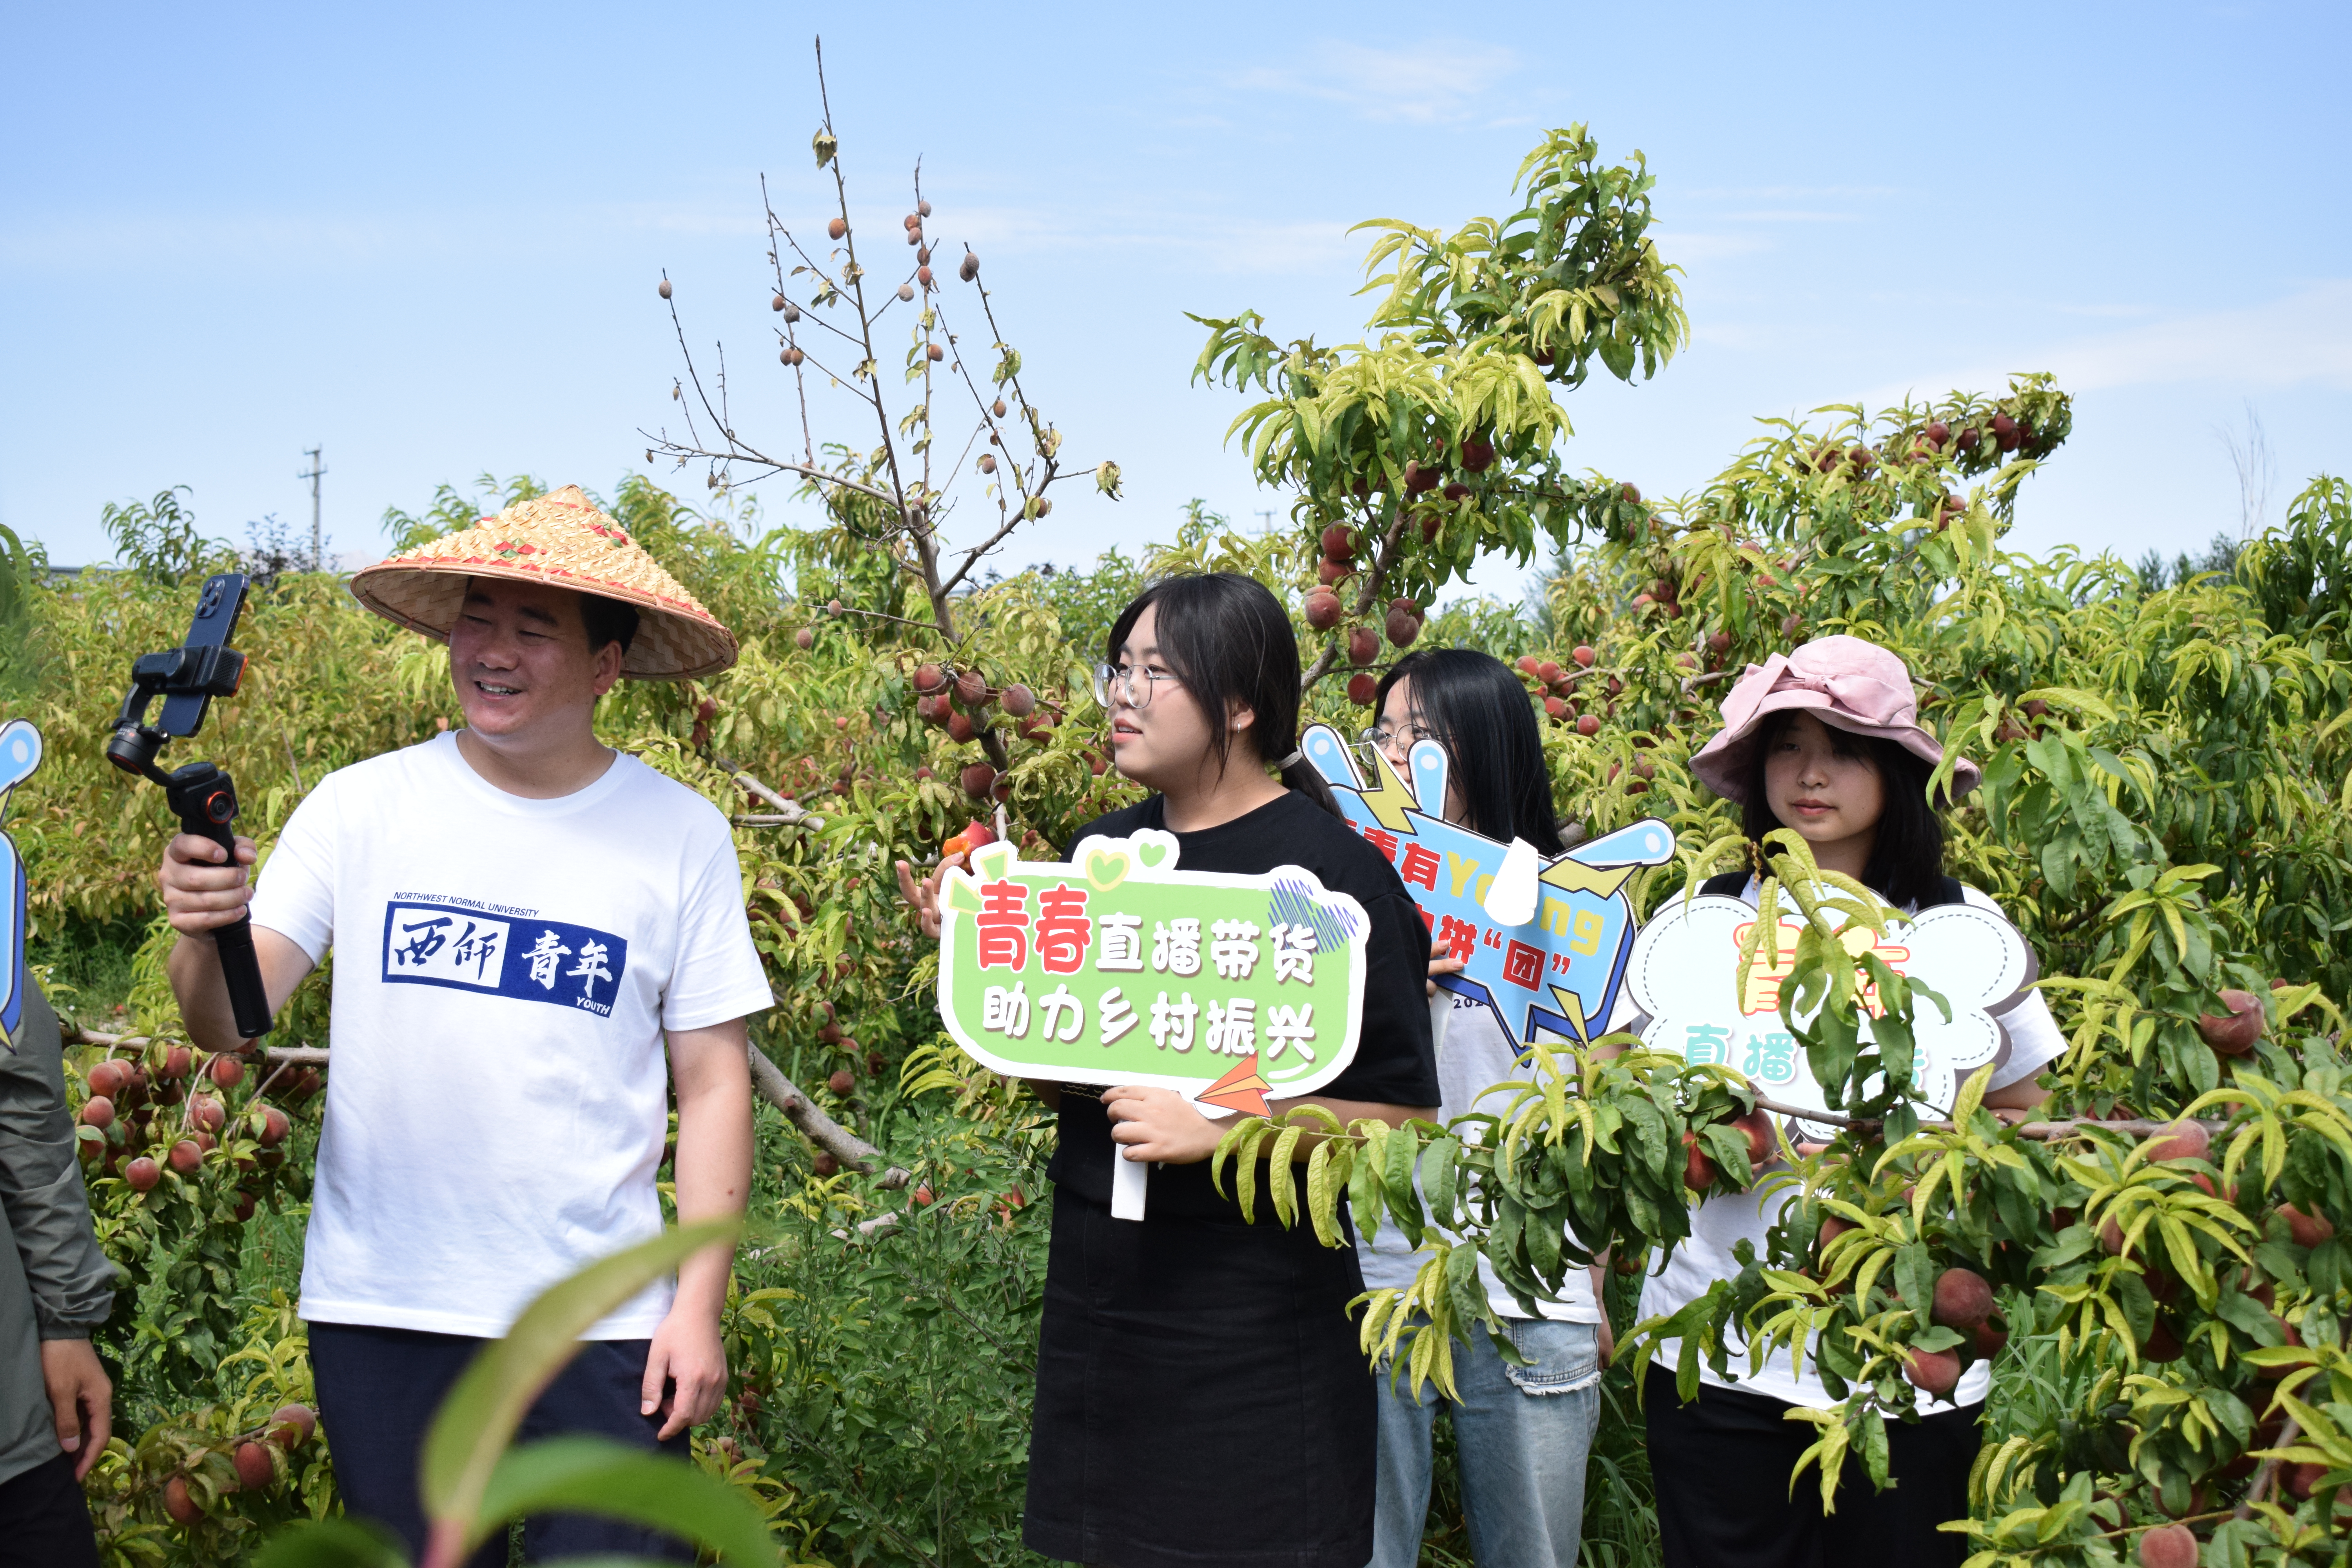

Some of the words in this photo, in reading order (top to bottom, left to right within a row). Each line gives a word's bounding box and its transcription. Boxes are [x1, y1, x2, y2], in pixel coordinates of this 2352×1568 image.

[394, 892, 448, 903] NORTHWEST
[448, 896, 485, 909] NORMAL
[488, 903, 539, 917] UNIVERSITY
[976, 878, 1317, 984] 青春直播带货
[522, 929, 613, 998] 青年
[576, 996, 611, 1015] YOUTH
[982, 980, 1315, 1060] 助力乡村振兴
